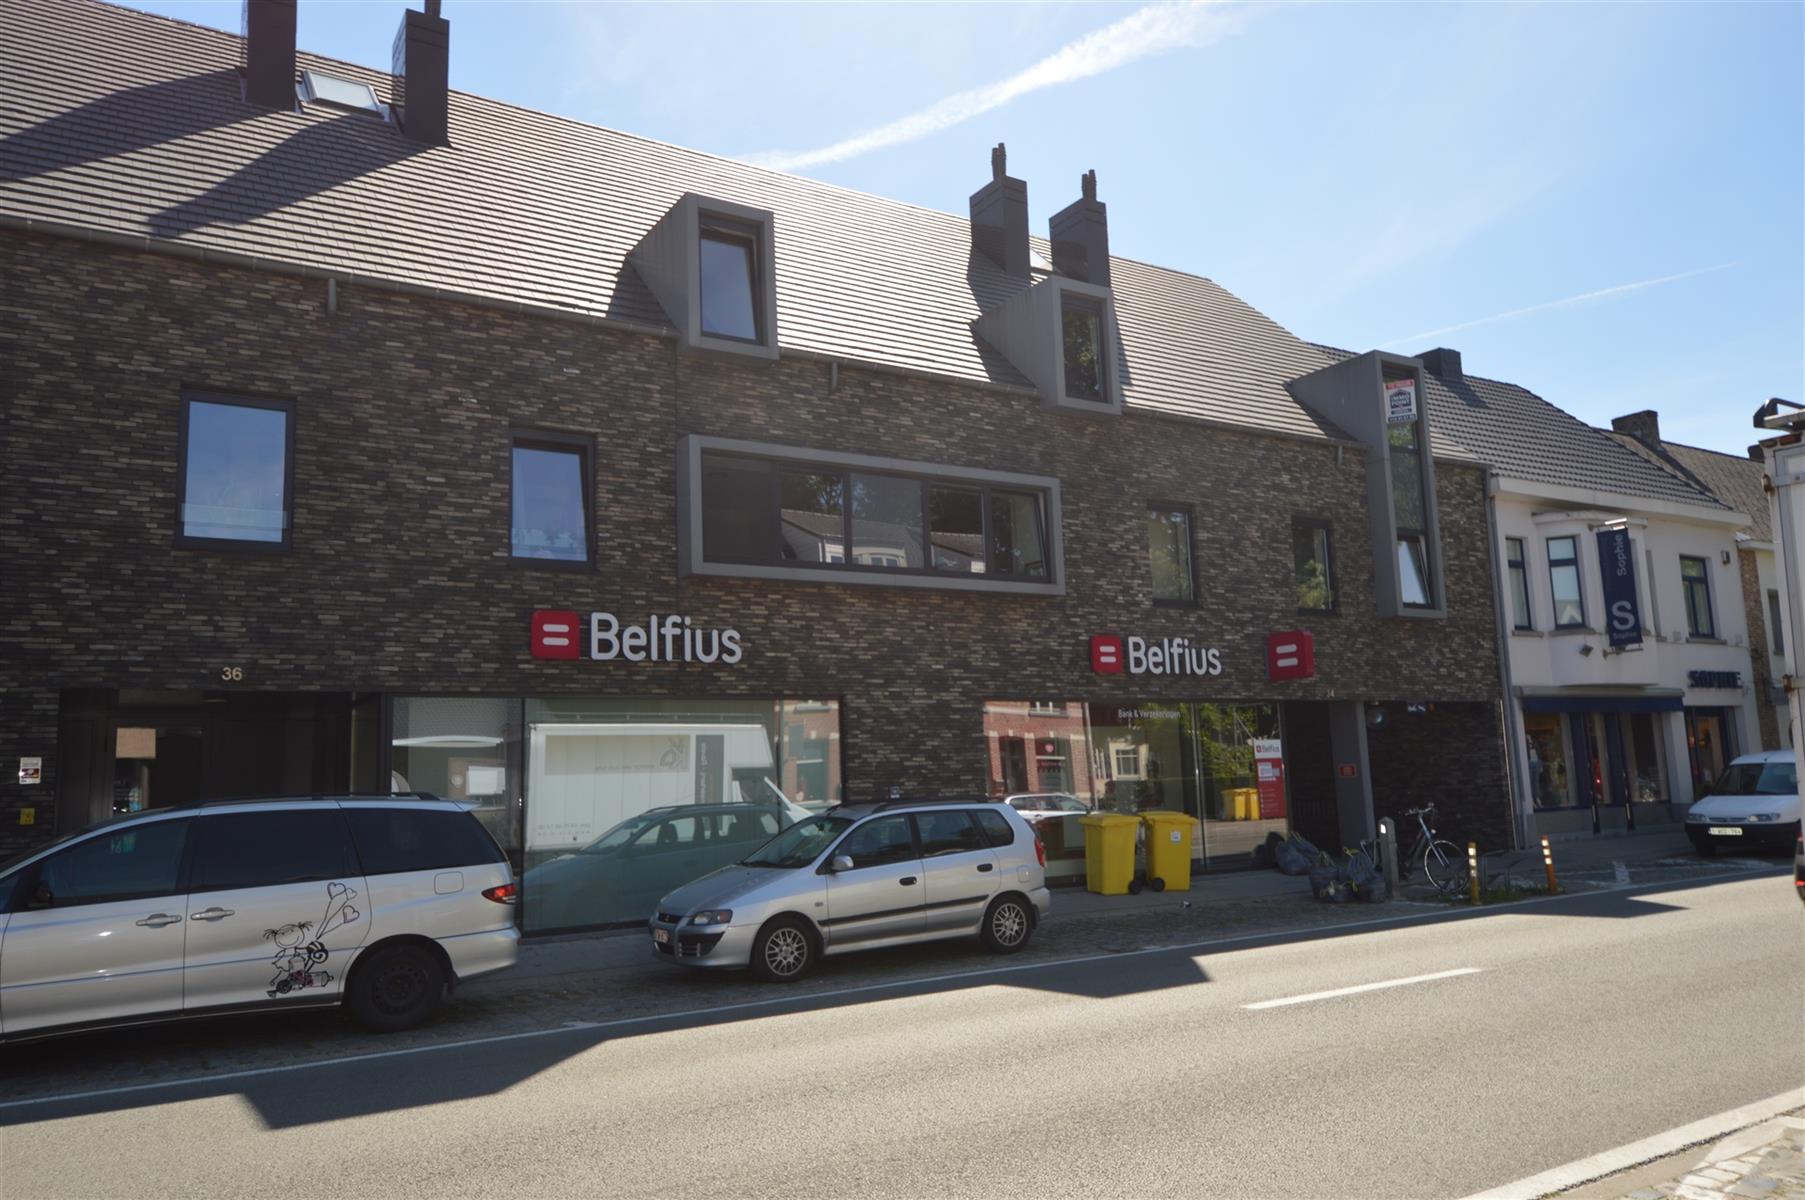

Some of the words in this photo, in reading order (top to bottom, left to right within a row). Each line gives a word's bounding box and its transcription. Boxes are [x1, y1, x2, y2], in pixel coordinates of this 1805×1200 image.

[1614, 533, 1628, 576] Sophie
[1612, 600, 1635, 631] S
[591, 612, 742, 664] Belfius
[1127, 636, 1222, 676] Belfius
[221, 668, 243, 681] 36
[1688, 670, 1743, 689] SOPHIE
[1118, 708, 1133, 718] Bank
